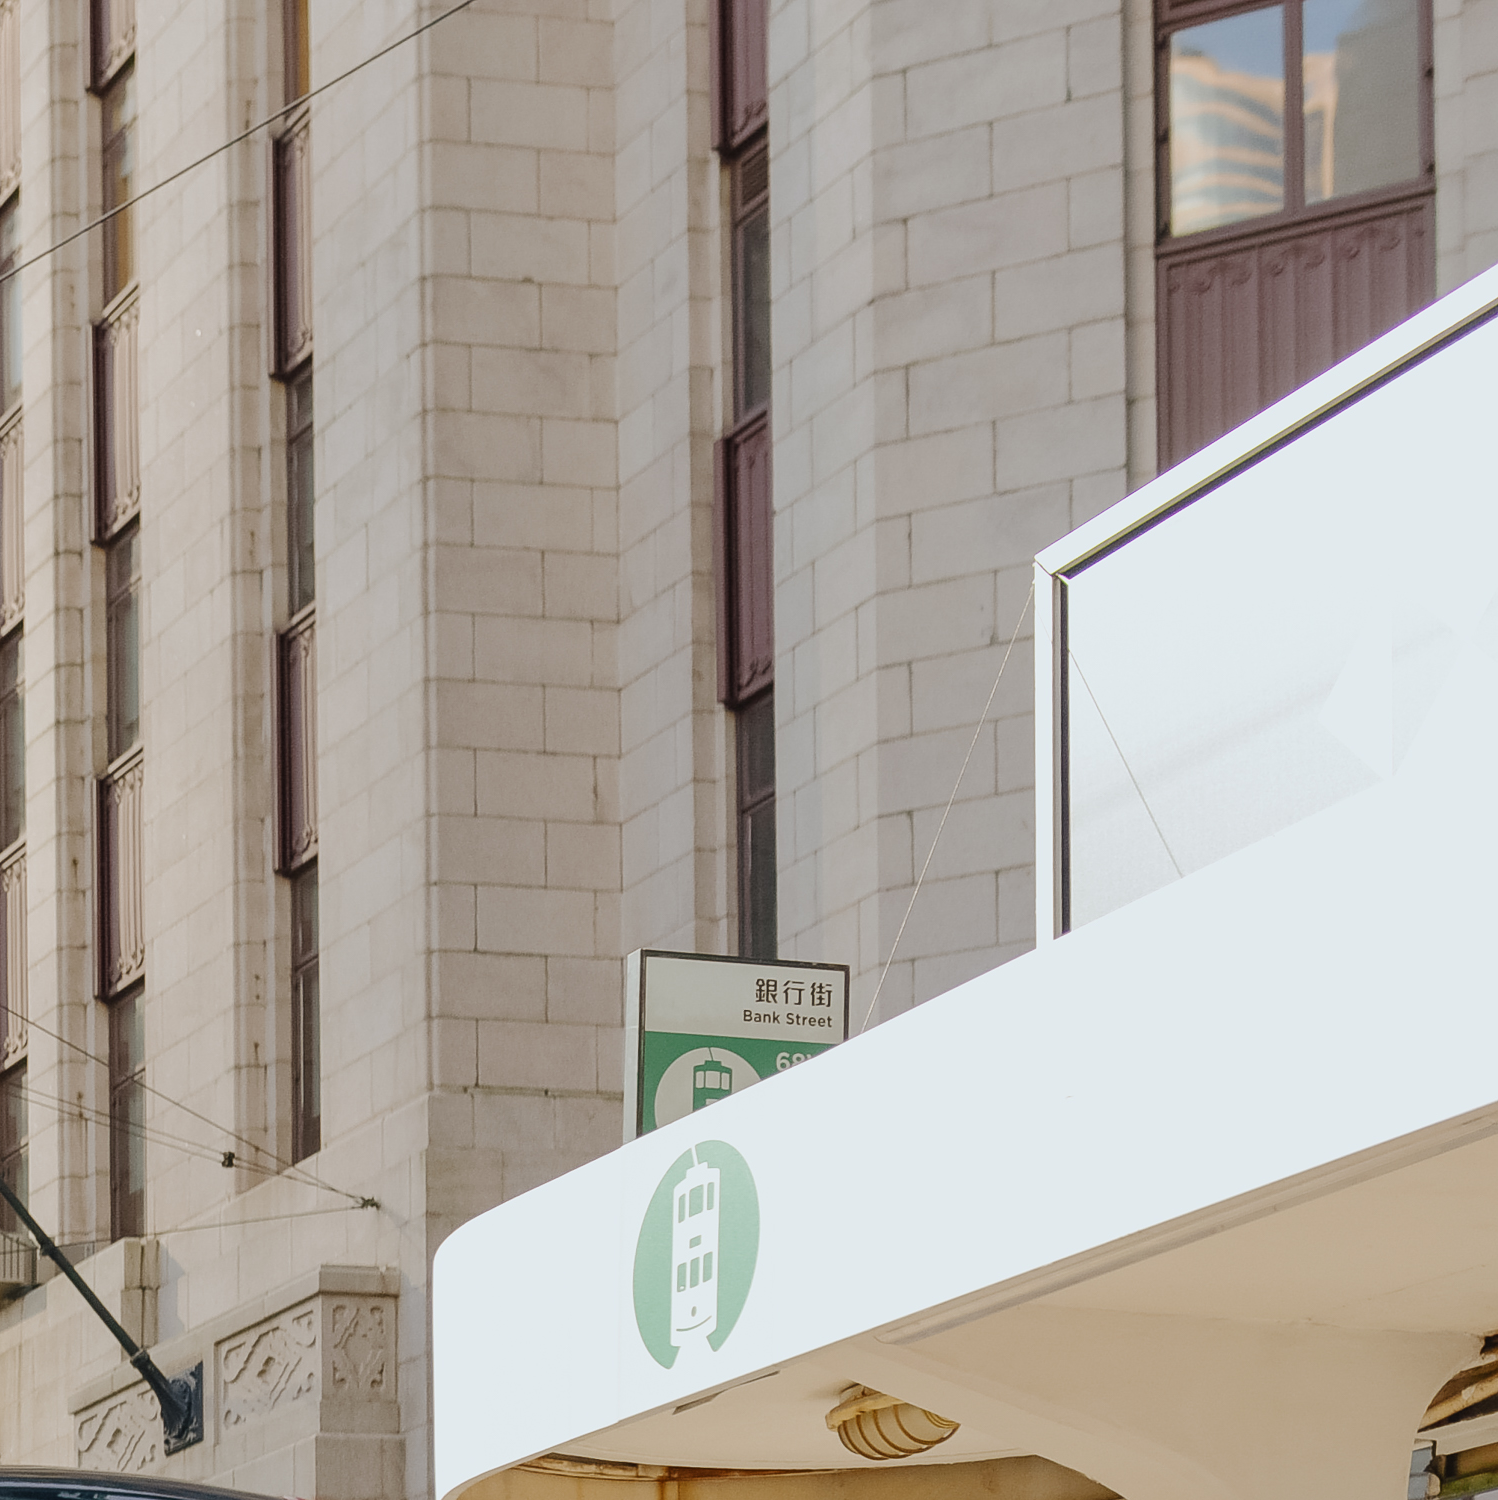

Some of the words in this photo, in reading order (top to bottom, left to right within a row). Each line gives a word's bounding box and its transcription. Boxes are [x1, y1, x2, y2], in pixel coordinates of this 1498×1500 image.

[755, 978, 833, 1007] 銀行街
[743, 1009, 780, 1025] Bank
[786, 1012, 833, 1028] Street
[776, 1052, 812, 1071] 68
